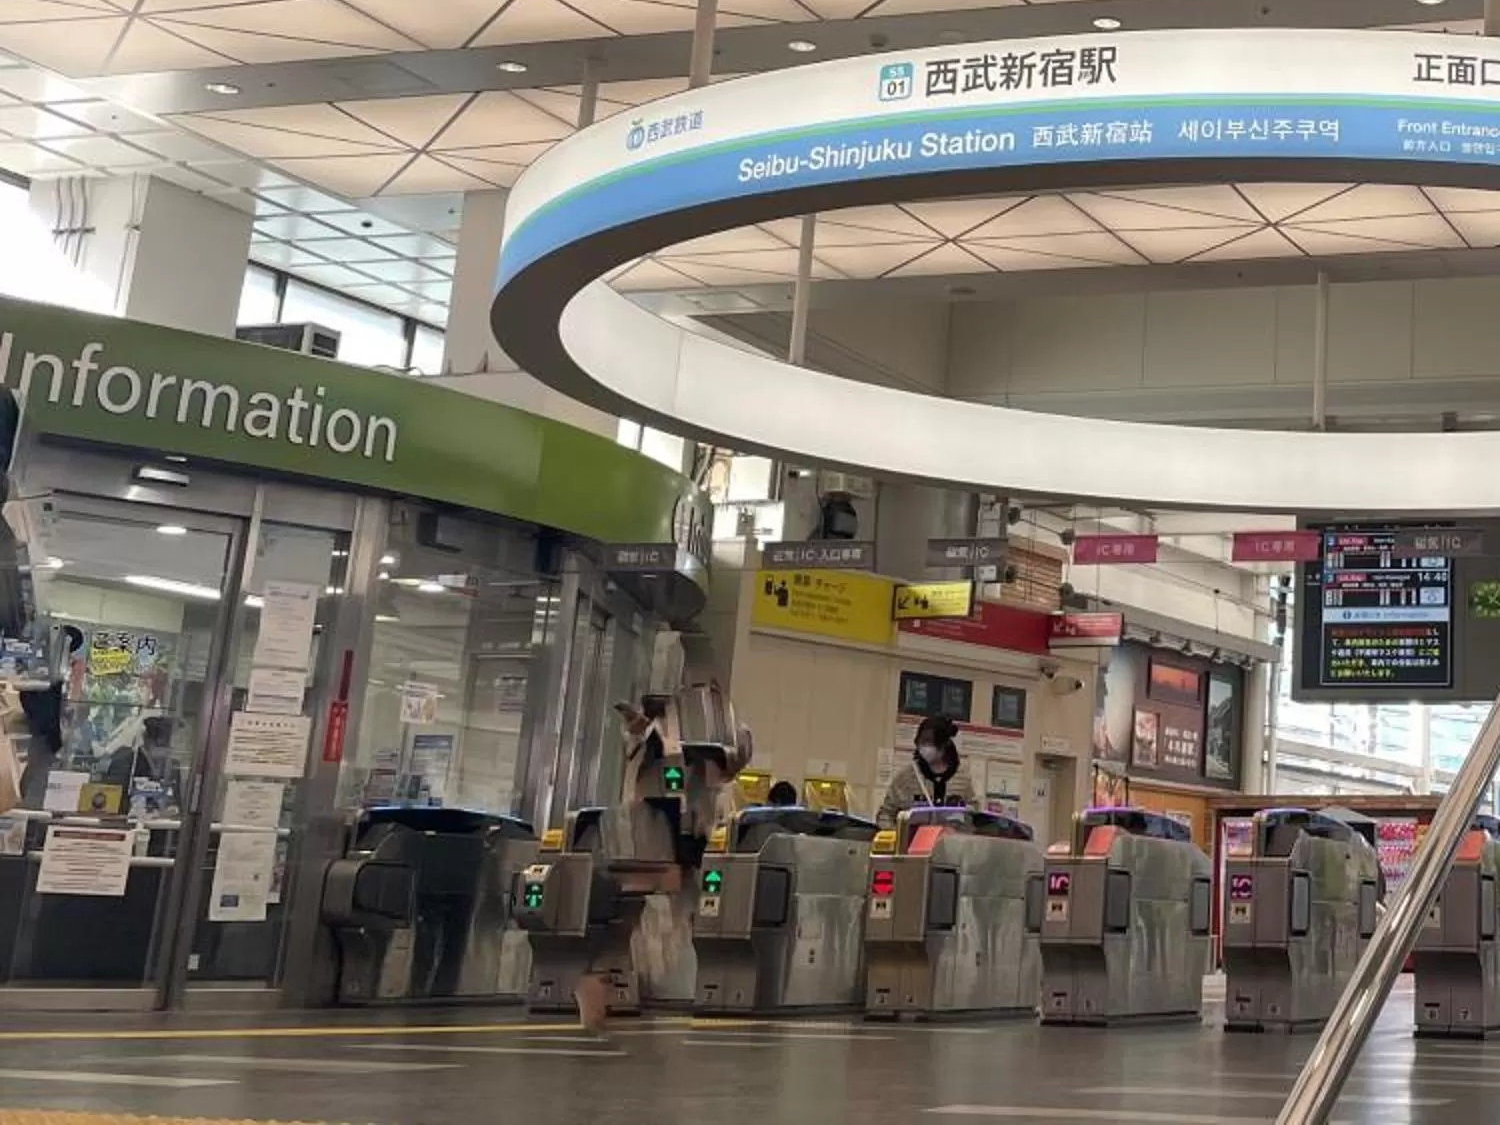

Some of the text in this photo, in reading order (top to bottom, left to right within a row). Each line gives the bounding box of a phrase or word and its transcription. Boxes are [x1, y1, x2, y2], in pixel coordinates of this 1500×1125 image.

[888, 66, 906, 77] SS
[924, 46, 1118, 97] 西武新宿駅
[886, 80, 905, 96] 01
[646, 109, 705, 143] 西武鉄道
[1032, 120, 1154, 148] 西武新宿站
[1177, 117, 1341, 142] 세이부신주쿠역
[1397, 118, 1437, 134] Front
[738, 129, 1016, 182] Seibu-Shinjuku Station
[0, 332, 398, 462] Information
